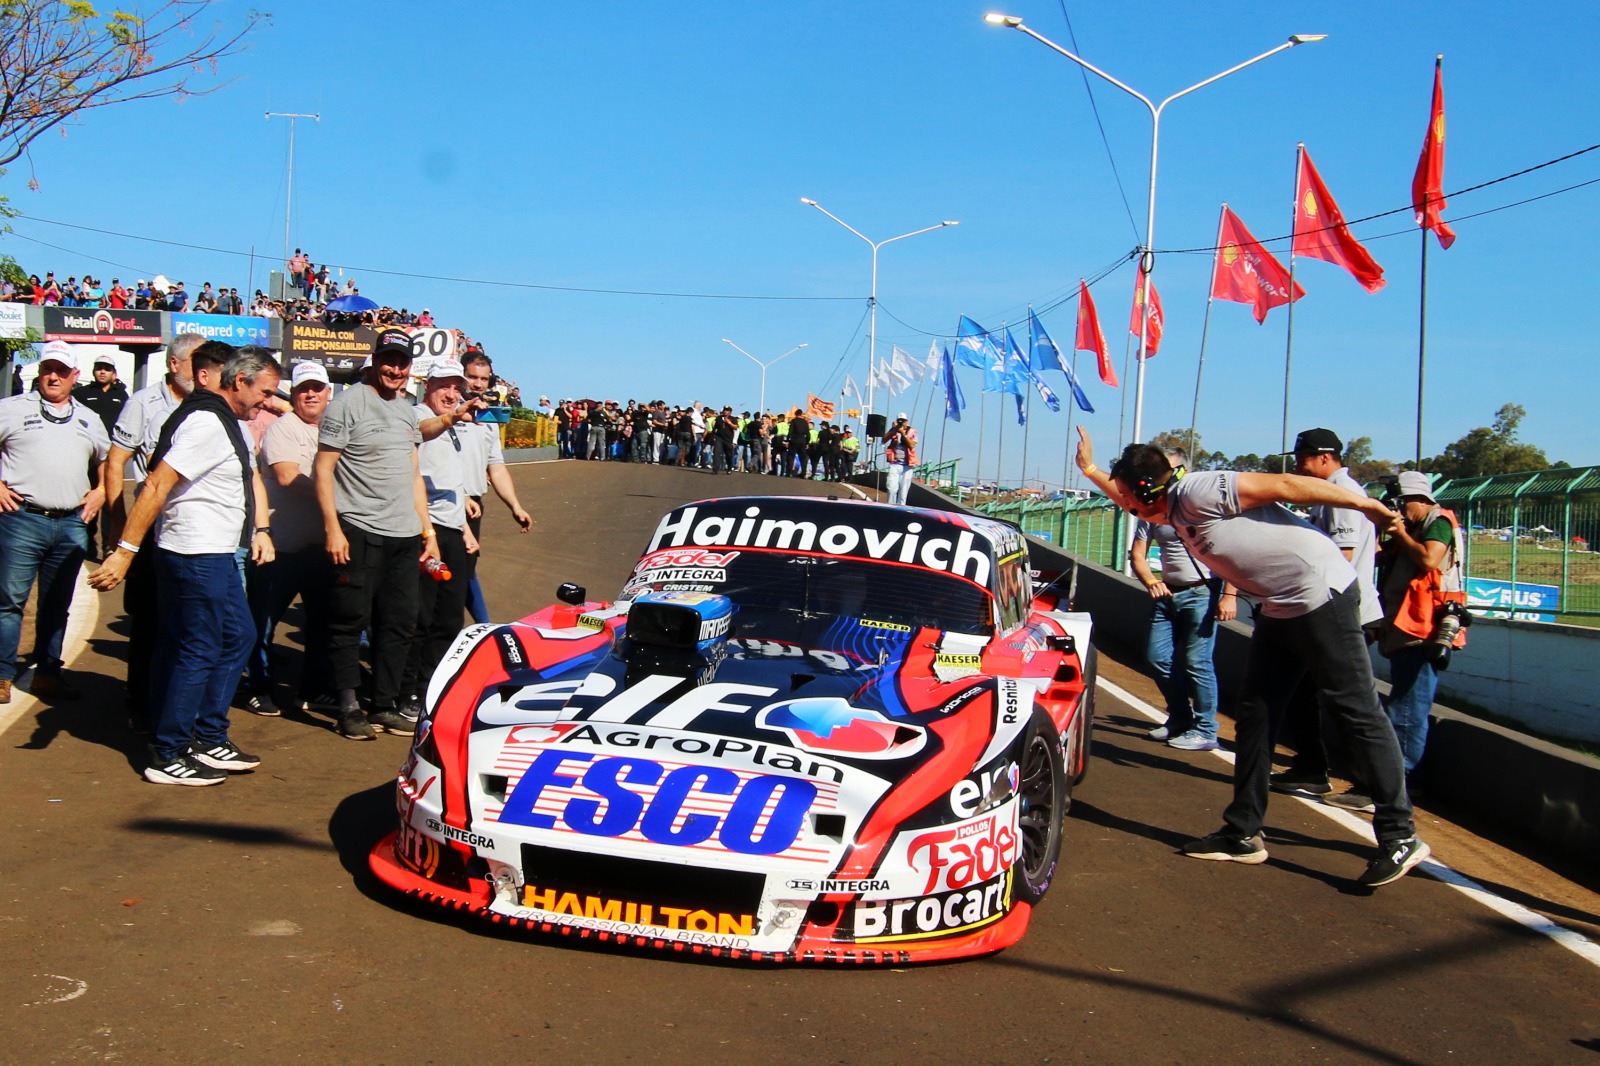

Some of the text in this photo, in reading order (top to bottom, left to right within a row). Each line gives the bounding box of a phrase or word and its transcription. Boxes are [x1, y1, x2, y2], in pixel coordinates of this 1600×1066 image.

[64, 315, 93, 329] Metal
[114, 317, 136, 331] Graf
[187, 322, 233, 338] Gigared
[293, 325, 355, 340] MANEJA CON
[292, 339, 371, 351] RESPONSABILIDAD
[411, 330, 448, 358] 60
[646, 506, 991, 587] Haimovich
[656, 569, 724, 580] INTEGRA
[662, 584, 714, 592] CRISTEM
[1500, 588, 1542, 608] RUS
[861, 620, 909, 632] KAESER
[938, 655, 979, 664] KAESER
[498, 749, 819, 855] ESCO
[960, 820, 989, 837] POLLOS
[443, 825, 495, 850] INTEGRA
[907, 801, 1018, 896] Fadel
[820, 880, 890, 892] INTEGRA
[523, 885, 753, 936] HAMILTON
[855, 873, 1006, 937] Brocart
[514, 910, 750, 949] PROFESSIONAL BRAND
